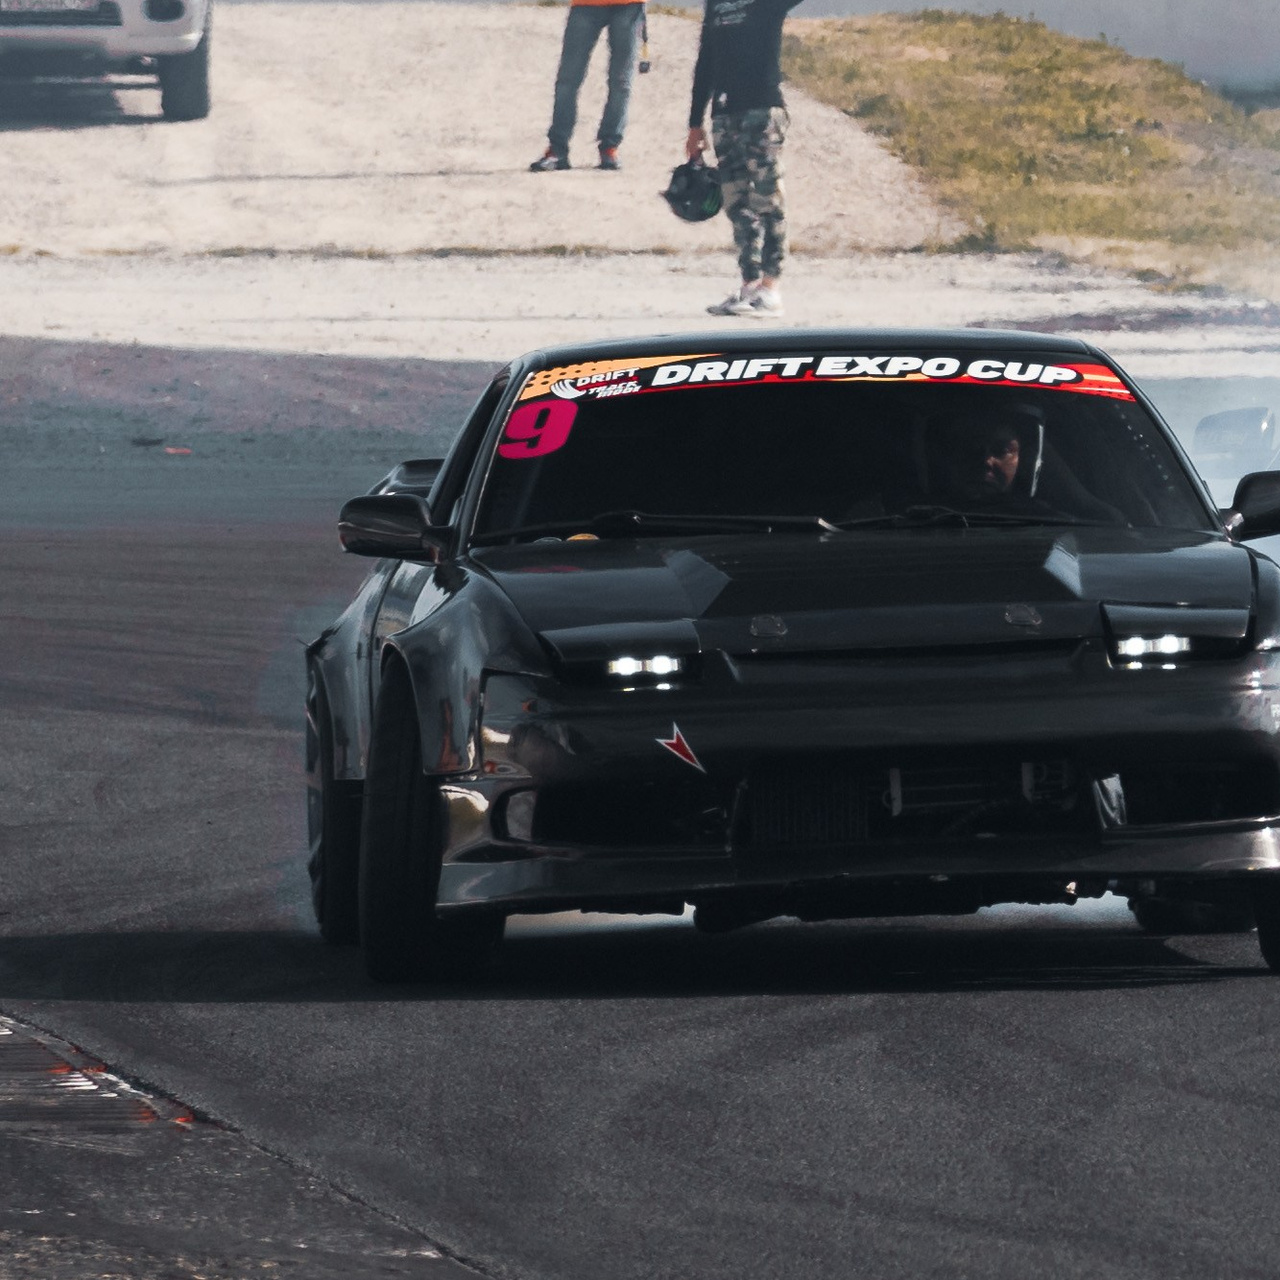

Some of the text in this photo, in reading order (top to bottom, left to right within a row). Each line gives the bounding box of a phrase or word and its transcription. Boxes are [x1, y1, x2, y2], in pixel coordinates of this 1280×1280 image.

[576, 367, 640, 386] DRIFT
[651, 356, 1078, 386] DRIFT EXPO CUP
[498, 399, 579, 460] 9
